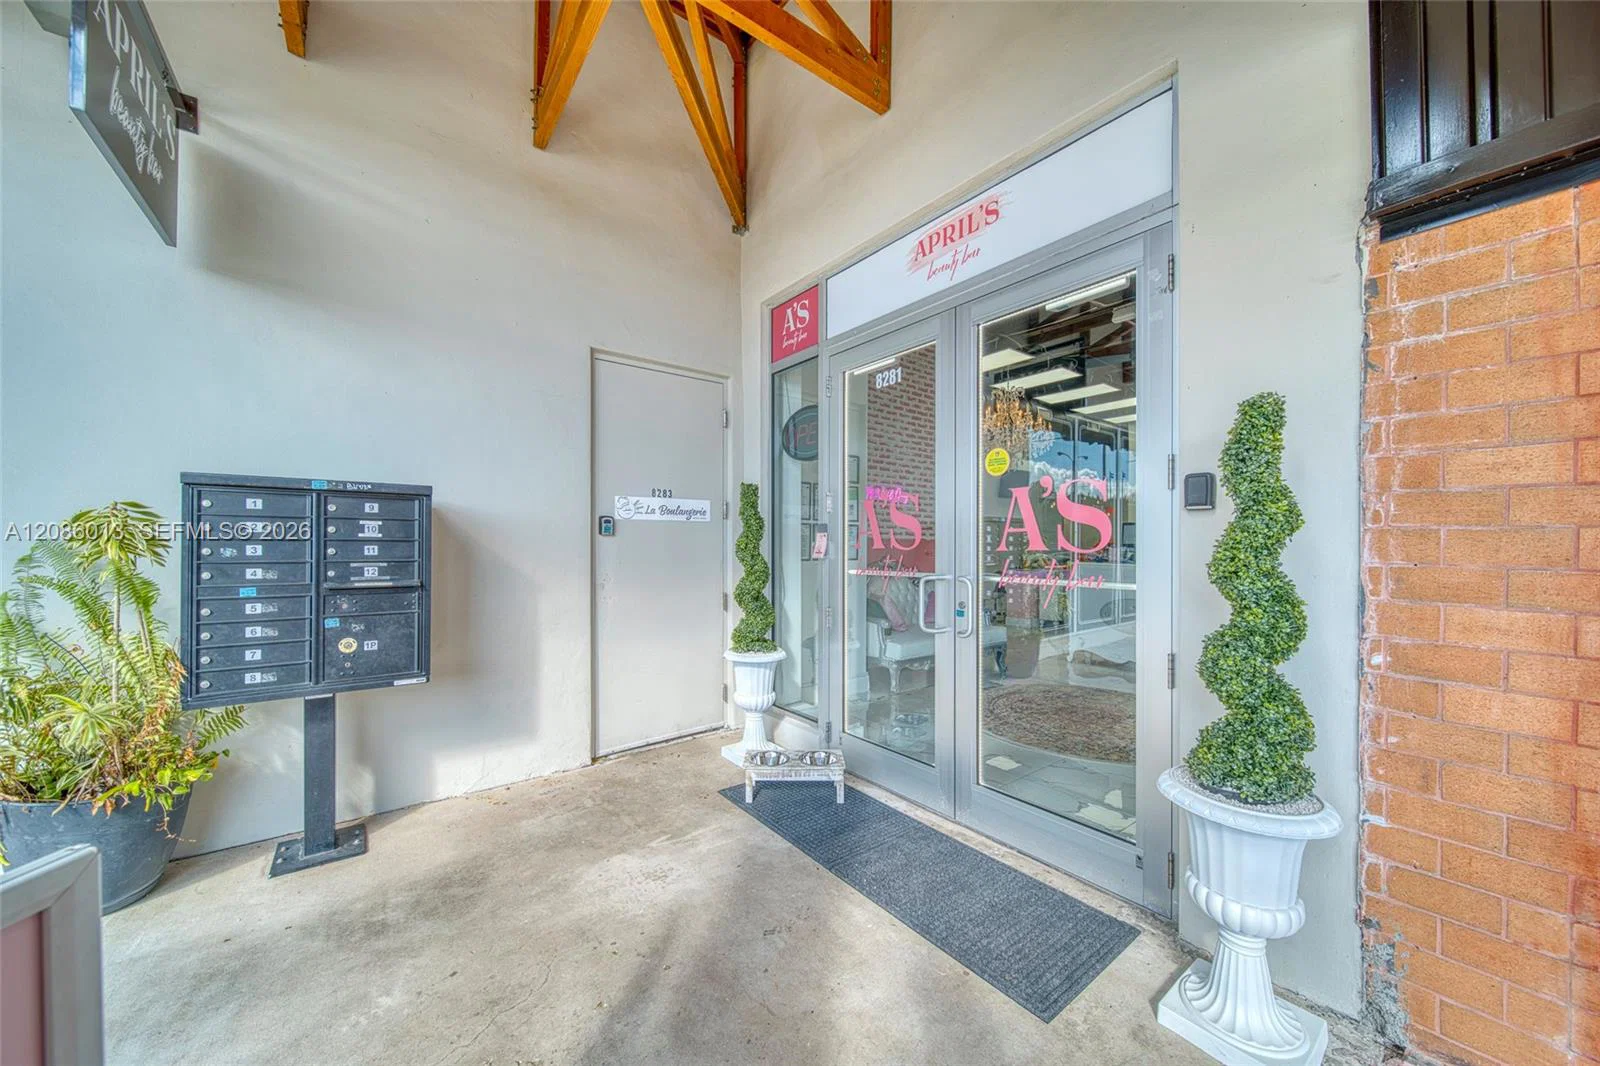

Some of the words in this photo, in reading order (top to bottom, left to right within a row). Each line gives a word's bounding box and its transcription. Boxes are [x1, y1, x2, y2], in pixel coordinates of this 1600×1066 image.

[93, 0, 175, 160] APRIL'S
[914, 200, 1000, 262] APRIL'S
[926, 249, 962, 281] beauty
[961, 243, 982, 266] bar
[782, 299, 810, 336] A'S
[875, 366, 902, 389] 8281
[651, 487, 673, 498] 8283
[644, 504, 657, 515] La
[658, 504, 707, 520] Boulangerie
[995, 475, 1113, 554] A'S
[998, 558, 1069, 609] beauty
[1065, 559, 1105, 592] bar
